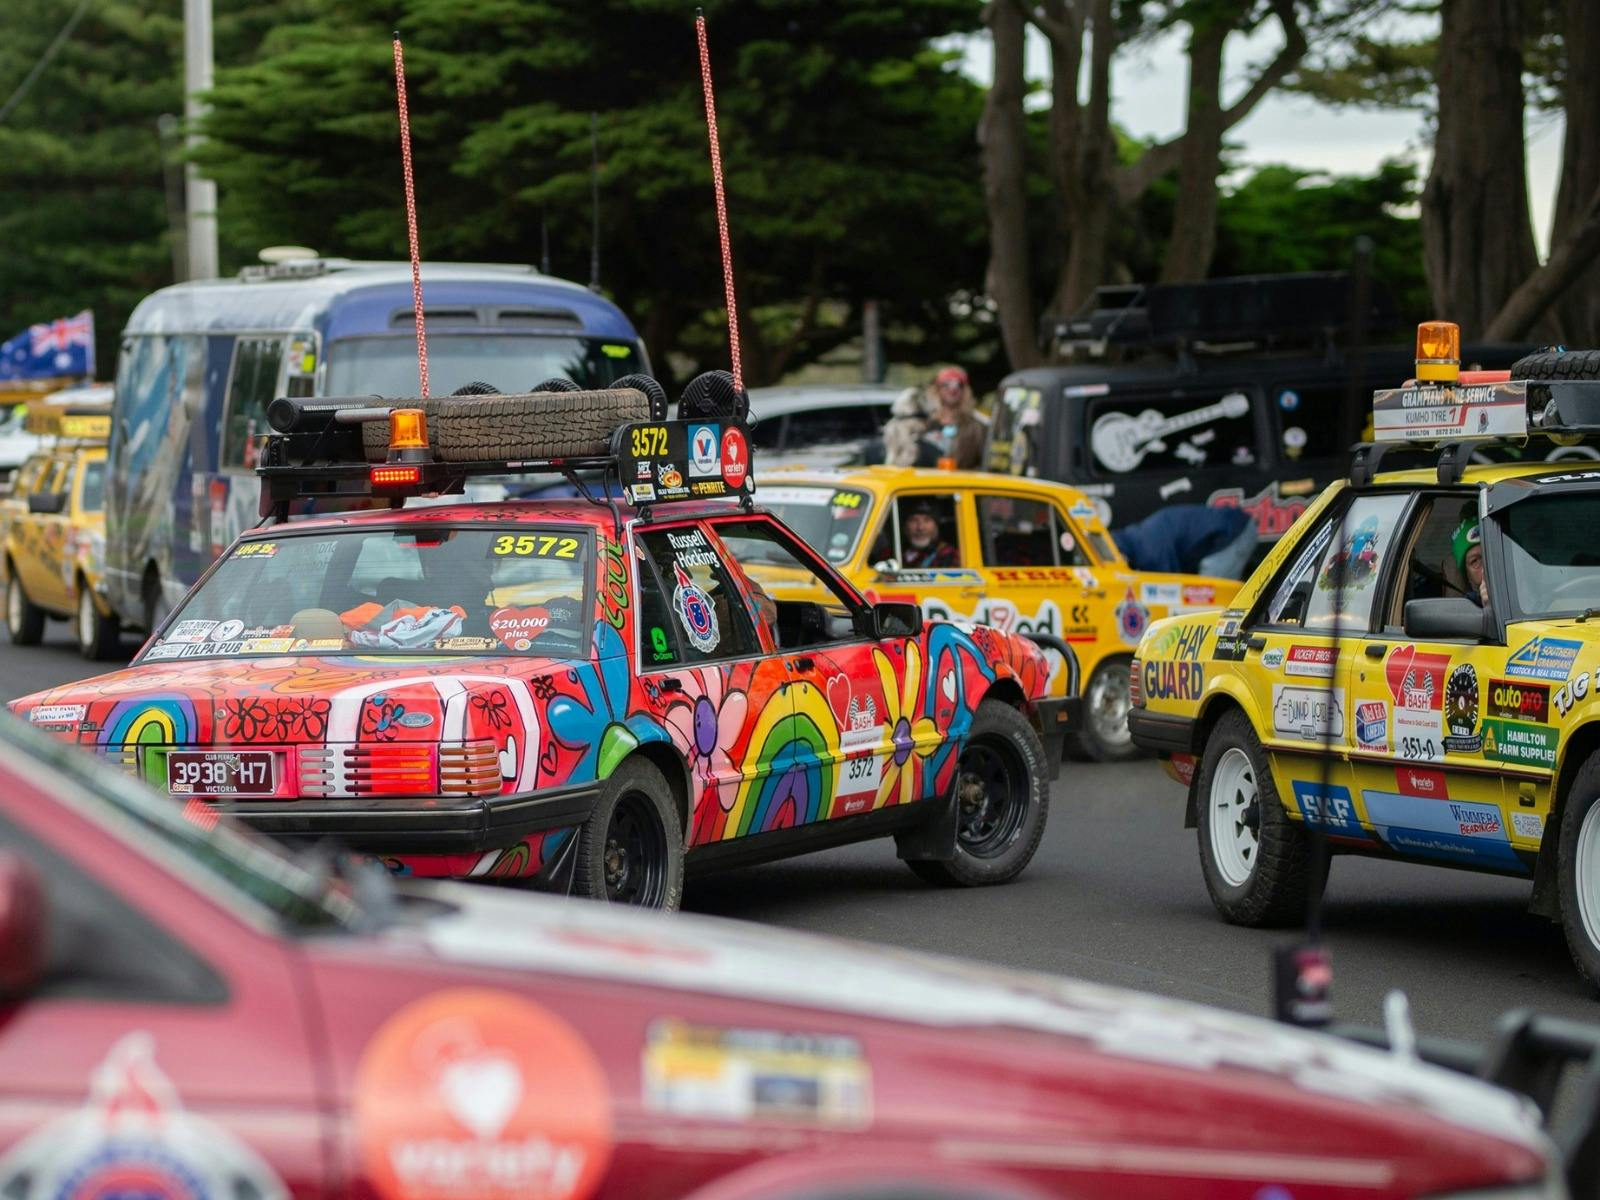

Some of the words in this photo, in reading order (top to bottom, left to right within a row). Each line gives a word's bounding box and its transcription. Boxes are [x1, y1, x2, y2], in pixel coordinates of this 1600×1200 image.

[1464, 387, 1496, 403] SERVICE
[1405, 410, 1430, 423] KUMHO
[1431, 410, 1446, 422] TYRE
[1406, 429, 1430, 437] HAMILTON
[632, 428, 668, 457] 3572
[724, 463, 744, 474] variety
[698, 481, 726, 494] PENRITE
[494, 536, 578, 558] 3572
[667, 530, 707, 549] Russell
[675, 548, 720, 568] Hocking
[491, 617, 548, 631] $20,000
[505, 629, 529, 640] plus
[1174, 624, 1212, 660] HAY
[185, 642, 215, 656] TILPA
[216, 641, 241, 654] PUB
[1294, 648, 1315, 660] VICKERY
[1543, 646, 1579, 657] SOUTHERN
[1506, 665, 1530, 674] LIVESTOCK
[1537, 669, 1549, 677] REAL
[1551, 671, 1568, 679] ESTATE
[1145, 661, 1203, 700] GUARD
[1408, 694, 1428, 709] BASH
[1494, 685, 1542, 714] autopro
[1553, 672, 1590, 717] TJG
[1363, 705, 1376, 720] Red
[854, 717, 872, 730] BASH
[1366, 721, 1385, 740] SHEDS
[1507, 730, 1546, 746] HAMILTON
[1498, 743, 1519, 756] FARM
[1520, 747, 1556, 762] SUPPLIES
[175, 762, 227, 784] 3938
[240, 762, 267, 784] H7
[849, 758, 874, 780] 3572
[1301, 794, 1349, 827] SKF
[1450, 804, 1499, 824] WIMMERA
[1460, 822, 1499, 836] BEARINGS
